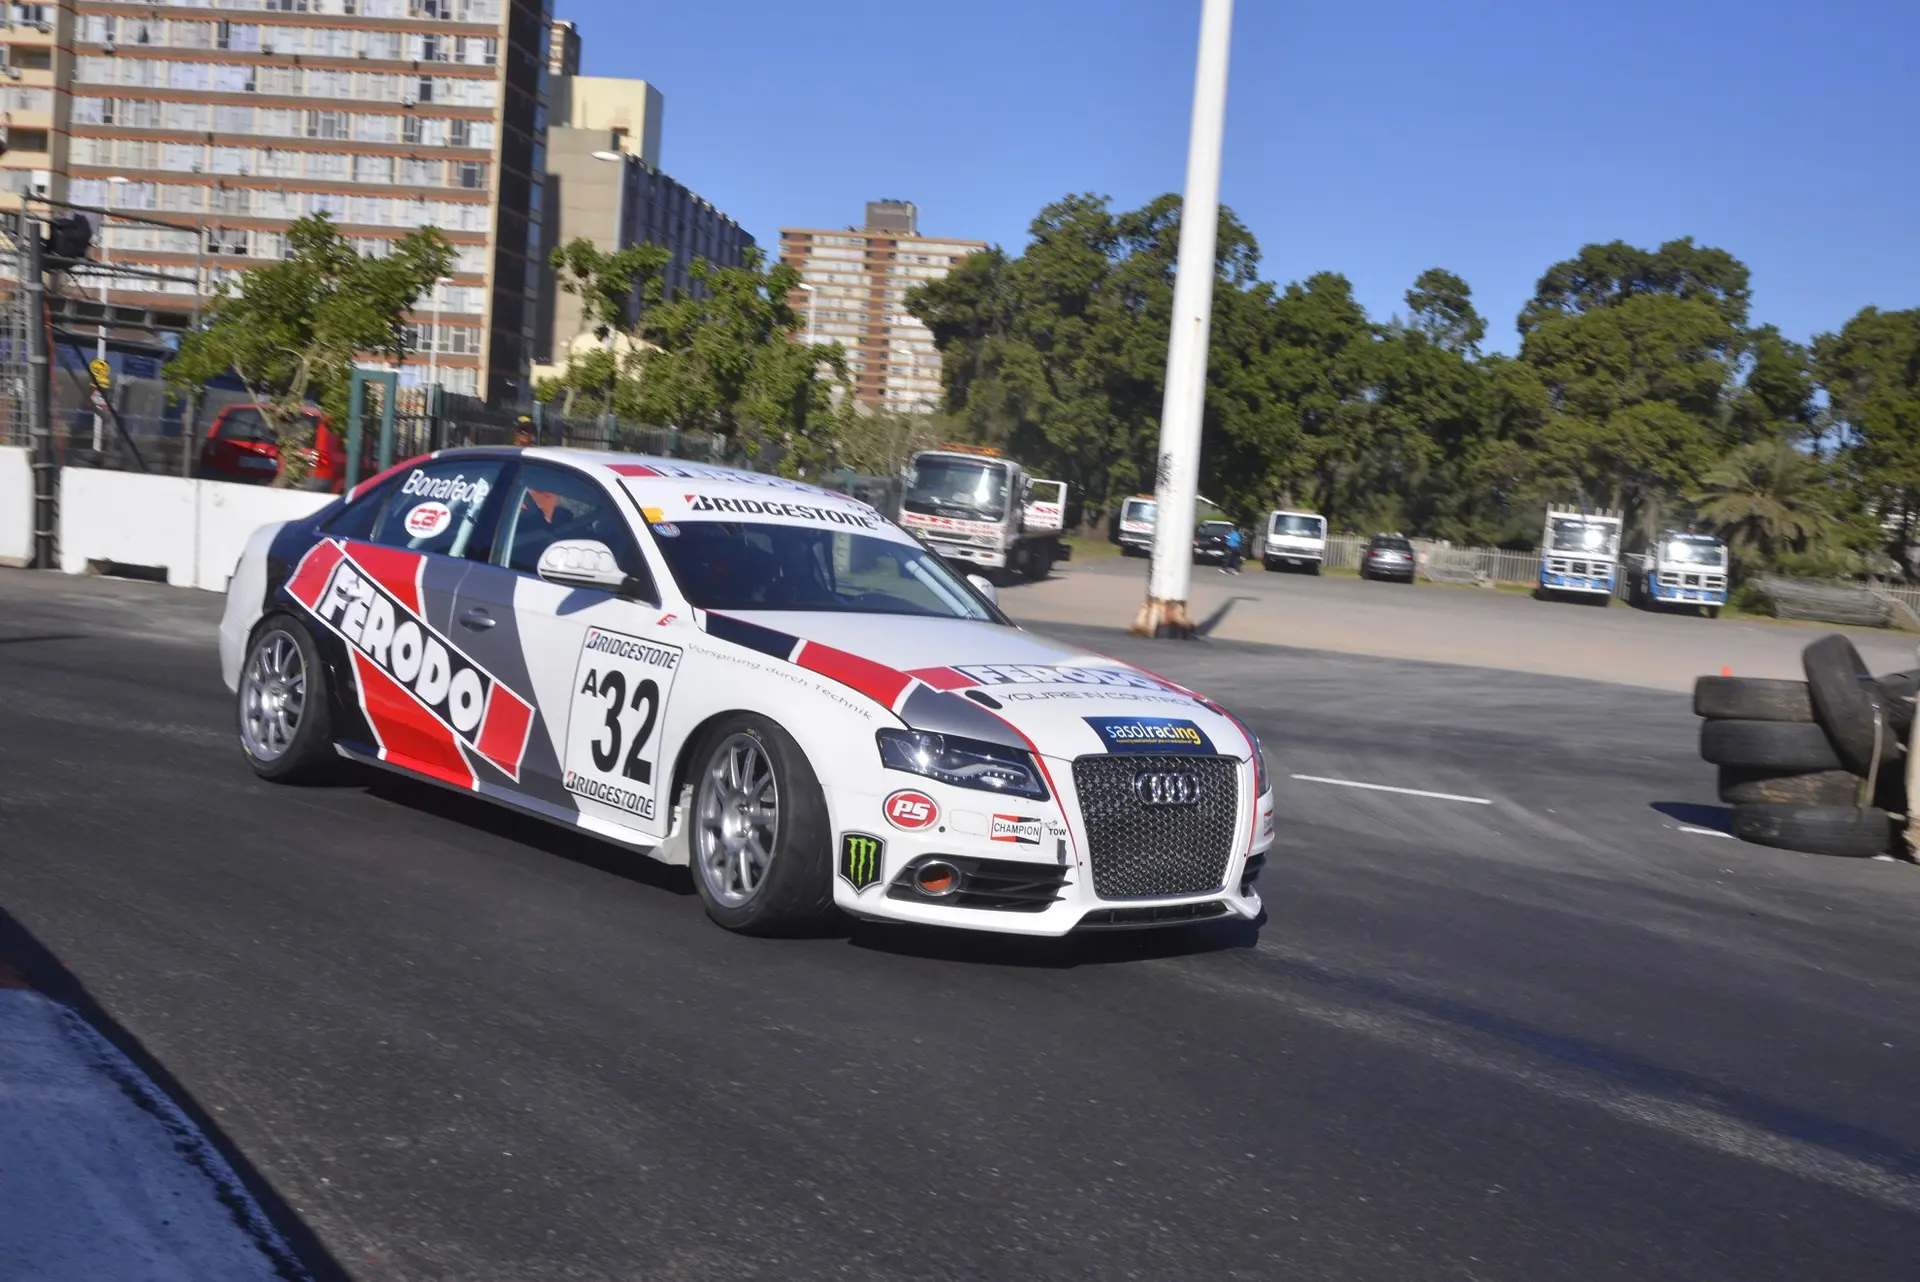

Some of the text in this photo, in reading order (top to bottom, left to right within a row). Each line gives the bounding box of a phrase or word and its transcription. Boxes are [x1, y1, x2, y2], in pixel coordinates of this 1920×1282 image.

[684, 494, 878, 531] BRIDGESTONE
[319, 562, 484, 732] FERODO
[585, 631, 680, 670] BRIDGESTONE
[688, 643, 872, 720] Vorsprung durch Technik
[1105, 721, 1202, 745] sasolracing
[566, 770, 654, 815] BRIDGESTONE
[892, 800, 930, 820] PS
[993, 822, 1040, 837] CHAMPION
[1049, 828, 1067, 836] TOW
